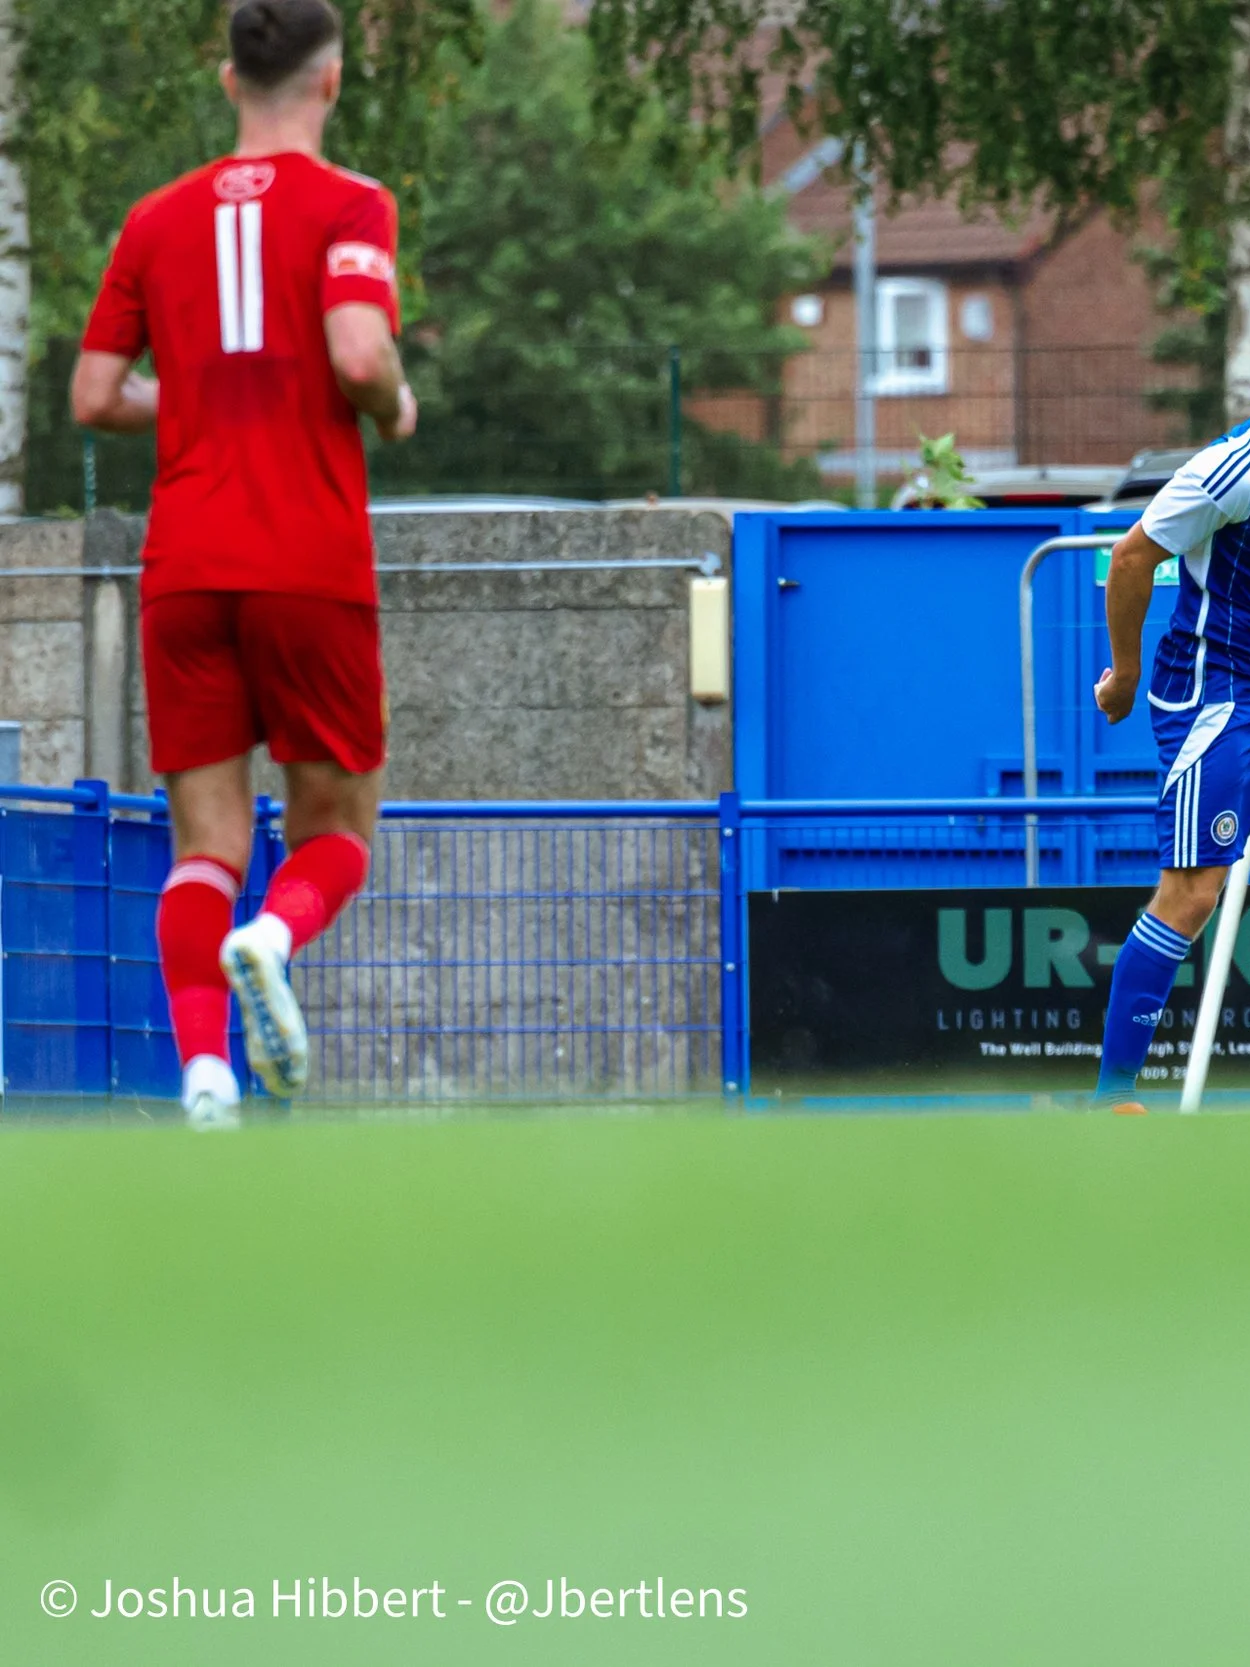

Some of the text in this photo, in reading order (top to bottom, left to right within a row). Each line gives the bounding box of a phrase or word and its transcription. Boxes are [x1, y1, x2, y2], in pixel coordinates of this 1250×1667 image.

[214, 201, 264, 354] 11
[936, 1007, 1082, 1031] LIGHTING
[979, 1042, 1007, 1056] The
